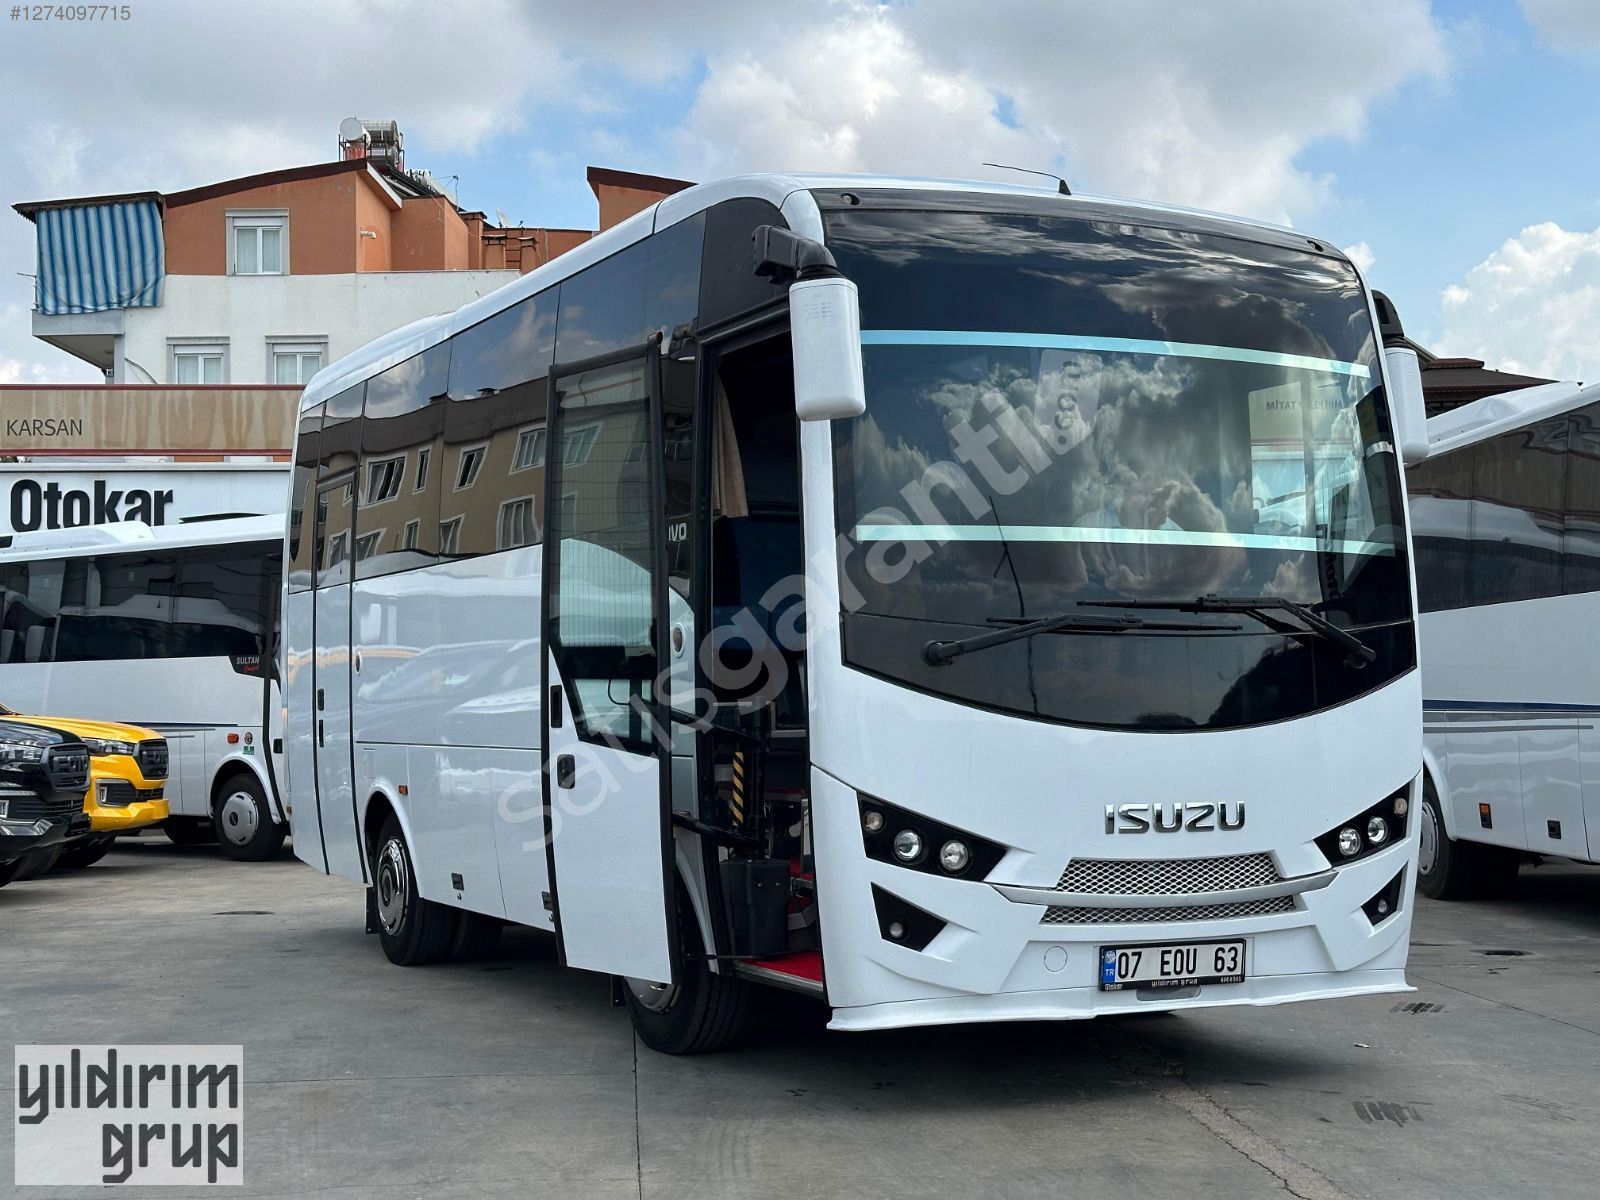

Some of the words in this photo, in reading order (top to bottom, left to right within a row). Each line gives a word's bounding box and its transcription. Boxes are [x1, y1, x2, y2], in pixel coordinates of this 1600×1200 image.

[6, 419, 83, 436] KARSAN
[10, 479, 173, 532] Otokar
[236, 656, 260, 665] SULTAN
[1105, 801, 1246, 834] ISUZU
[1105, 968, 1115, 976] TR
[1118, 951, 1142, 979] 07
[1214, 946, 1238, 973] 63
